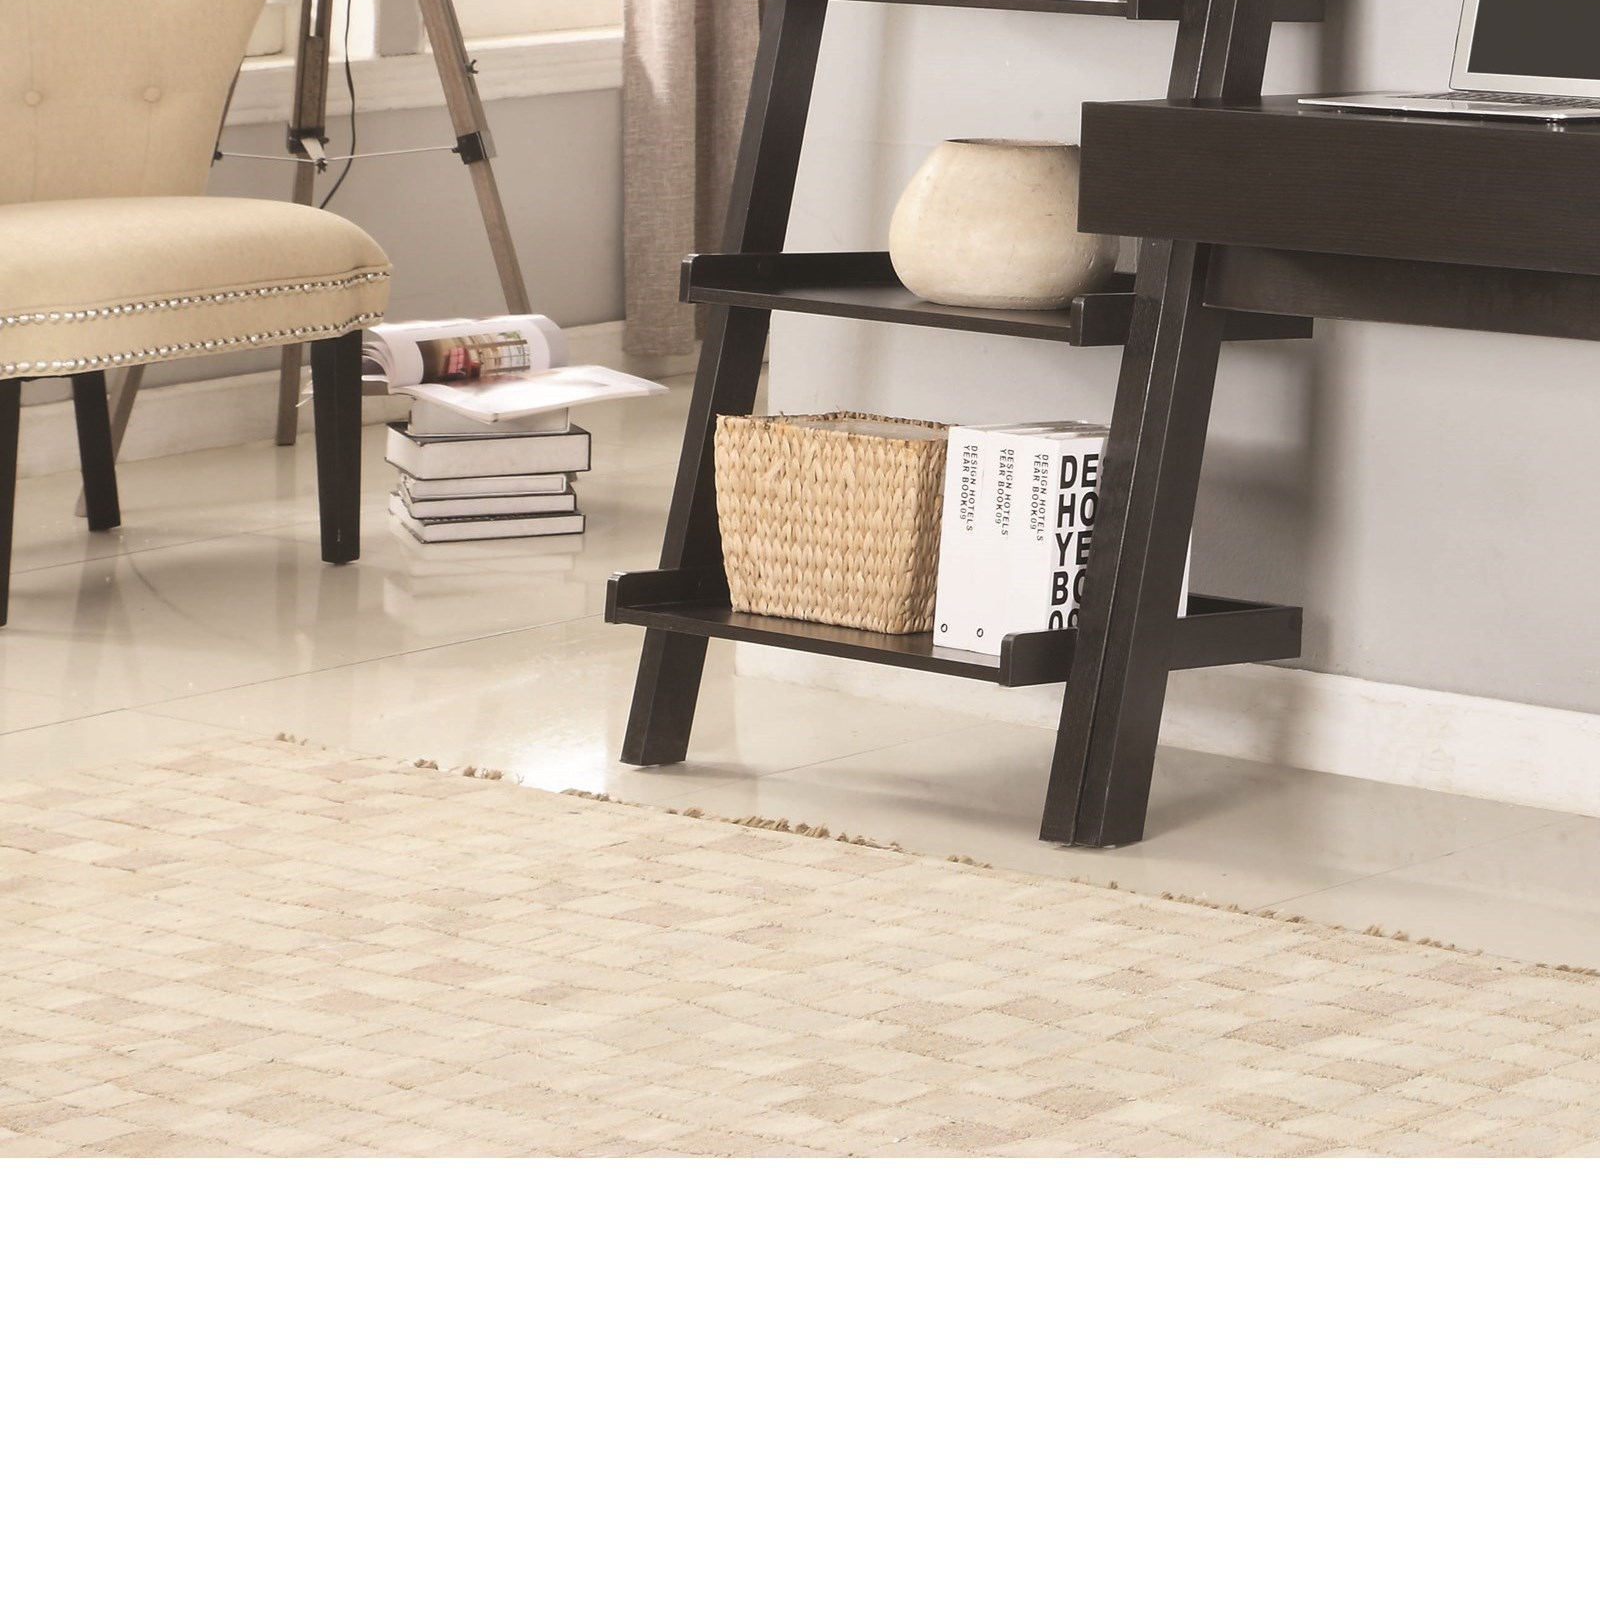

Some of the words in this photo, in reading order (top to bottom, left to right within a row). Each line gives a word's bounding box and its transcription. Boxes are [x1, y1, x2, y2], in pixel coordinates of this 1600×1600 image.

[962, 445, 970, 472] YEAR
[970, 445, 978, 485] DESIGN
[998, 448, 1007, 476] YEAR
[1005, 449, 1014, 489] DESIGN
[1033, 454, 1041, 481] YEAR
[1040, 454, 1049, 494] DESIGN
[966, 489, 976, 531] HOTELS
[1001, 494, 1011, 536] HOTELS
[1036, 499, 1046, 542] HOTELS
